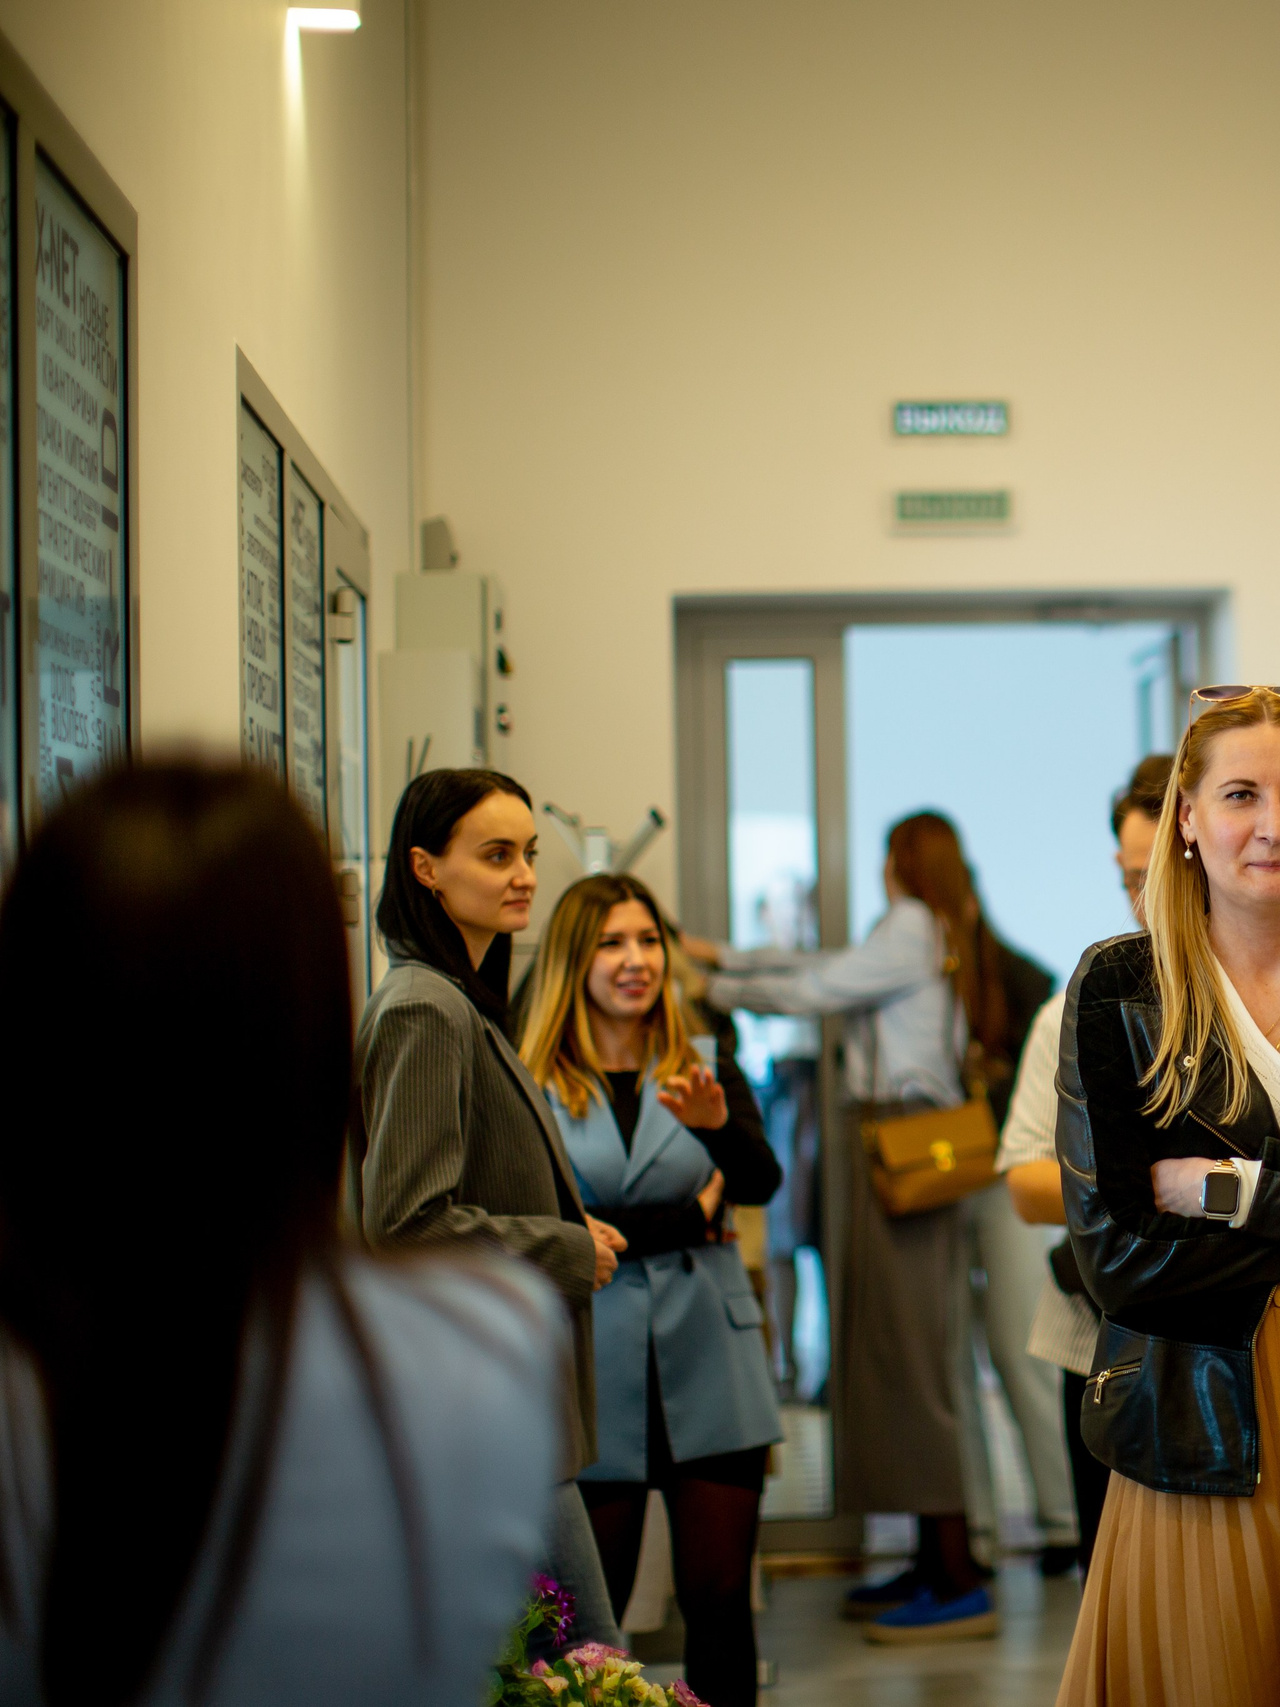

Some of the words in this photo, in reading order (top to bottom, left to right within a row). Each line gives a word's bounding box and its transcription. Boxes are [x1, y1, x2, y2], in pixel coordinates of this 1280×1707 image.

[36, 200, 79, 315] X-NET
[80, 279, 109, 347] НОВЫЕ
[42, 354, 98, 429] КВАНТОРИУМ
[80, 324, 117, 398] ОТРАСЛИ
